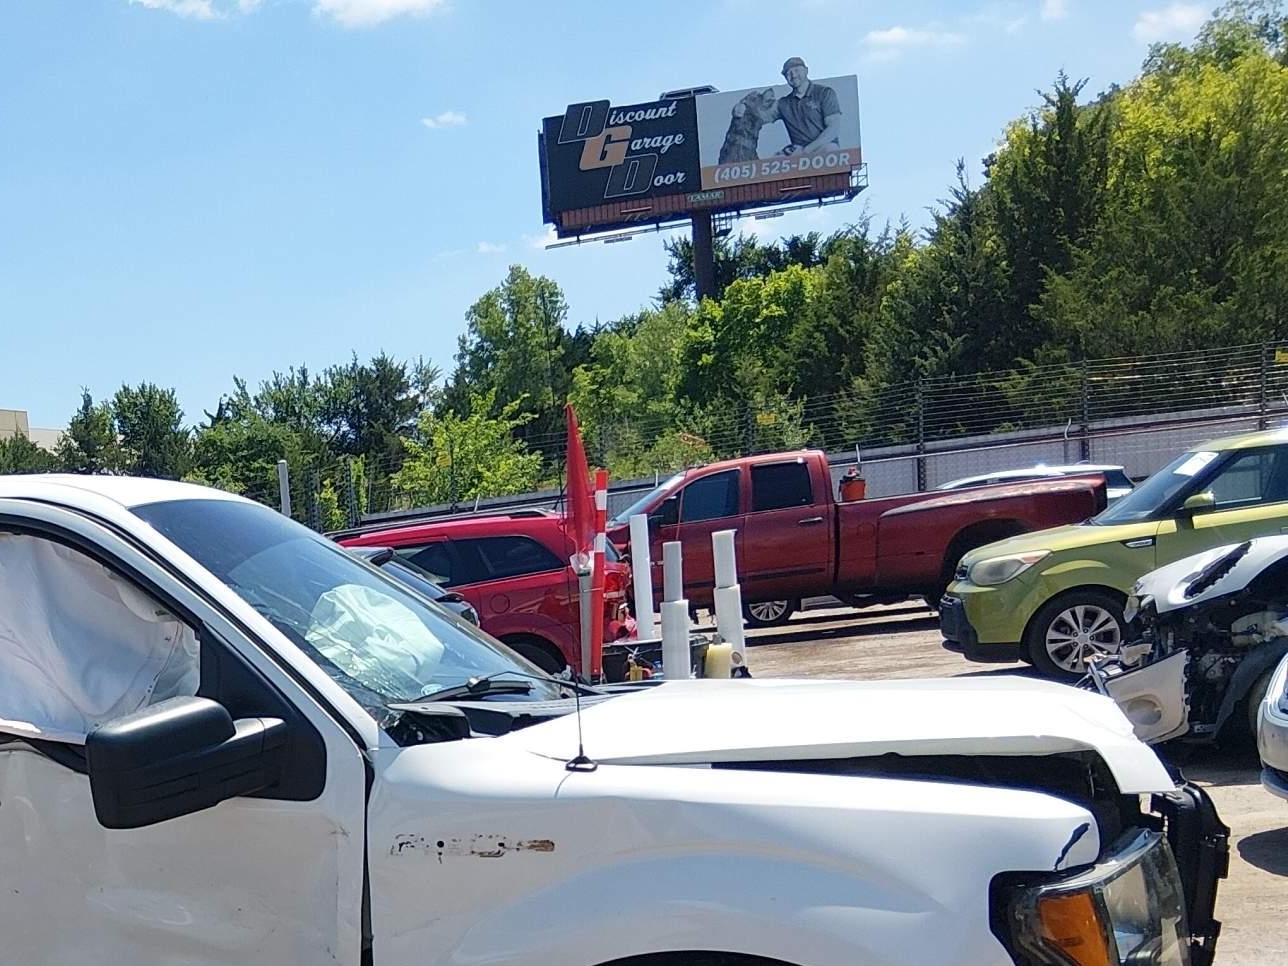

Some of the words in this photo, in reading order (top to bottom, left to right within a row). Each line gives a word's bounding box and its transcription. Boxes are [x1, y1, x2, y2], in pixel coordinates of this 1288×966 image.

[558, 100, 677, 144] Discount
[579, 125, 685, 171] Garage
[714, 163, 756, 183] (405)
[761, 153, 850, 176] 525-DOOR
[604, 153, 687, 198] Door
